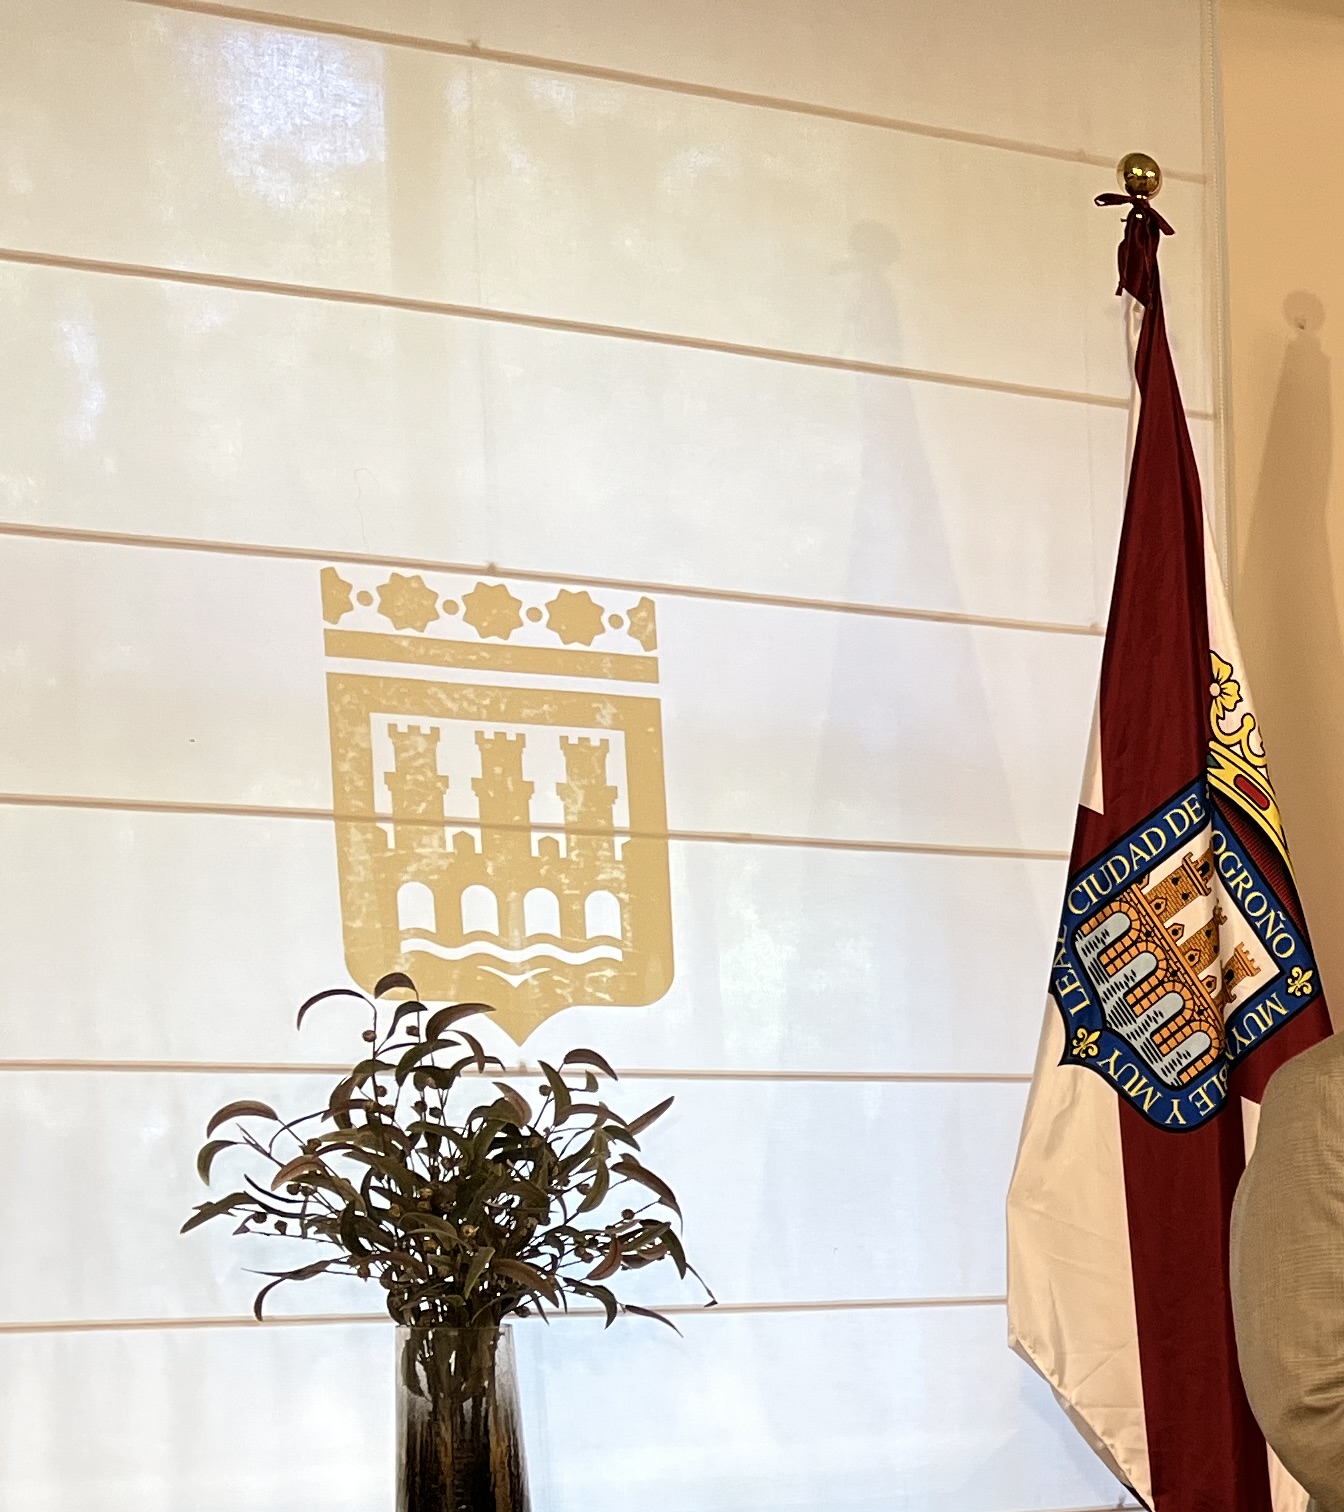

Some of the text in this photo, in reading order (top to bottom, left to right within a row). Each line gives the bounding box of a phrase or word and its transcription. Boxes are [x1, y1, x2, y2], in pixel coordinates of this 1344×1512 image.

[1067, 793, 1296, 959] CIUDAD DE OGROÑO
[1231, 991, 1290, 1055] MUY
[1096, 1047, 1164, 1114] MUY
[1164, 1098, 1188, 1125] Y
